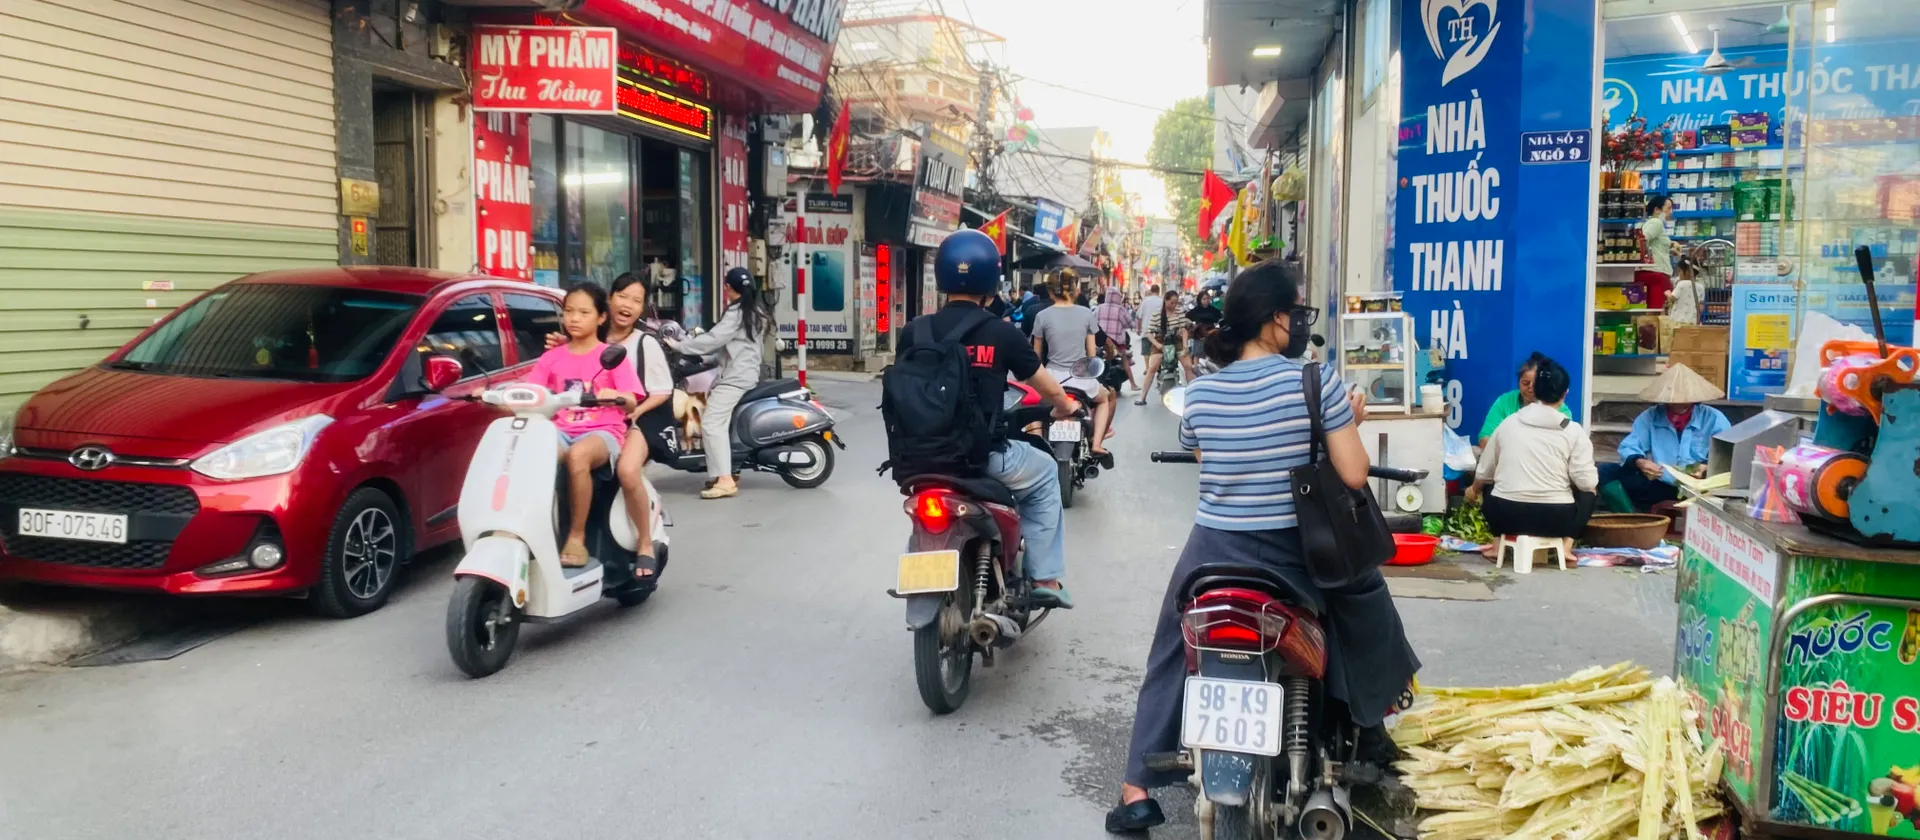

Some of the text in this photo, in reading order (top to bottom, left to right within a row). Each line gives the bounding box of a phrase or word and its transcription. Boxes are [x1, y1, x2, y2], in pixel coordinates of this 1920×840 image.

[480, 29, 610, 69] MỸ PHẨM
[1447, 16, 1475, 42] TH
[480, 66, 529, 101] Thu
[1738, 56, 1853, 100] THUỐC
[1426, 88, 1487, 155] NHÀ
[1528, 130, 1585, 146] NHÀ SỐ 2
[1529, 146, 1582, 162] NGÕ 9
[1412, 151, 1500, 224] THUỐC
[826, 222, 849, 245] GÓP
[484, 229, 528, 279] PHỤ
[1409, 239, 1504, 291] THANH
[1431, 300, 1468, 360] HÀ
[1220, 652, 1251, 660] HONDA
[1786, 611, 1893, 666] NƯỚC
[1199, 683, 1268, 716] 98-K9
[1784, 679, 1920, 733] SIÊU S
[1197, 714, 1267, 748] 7603
